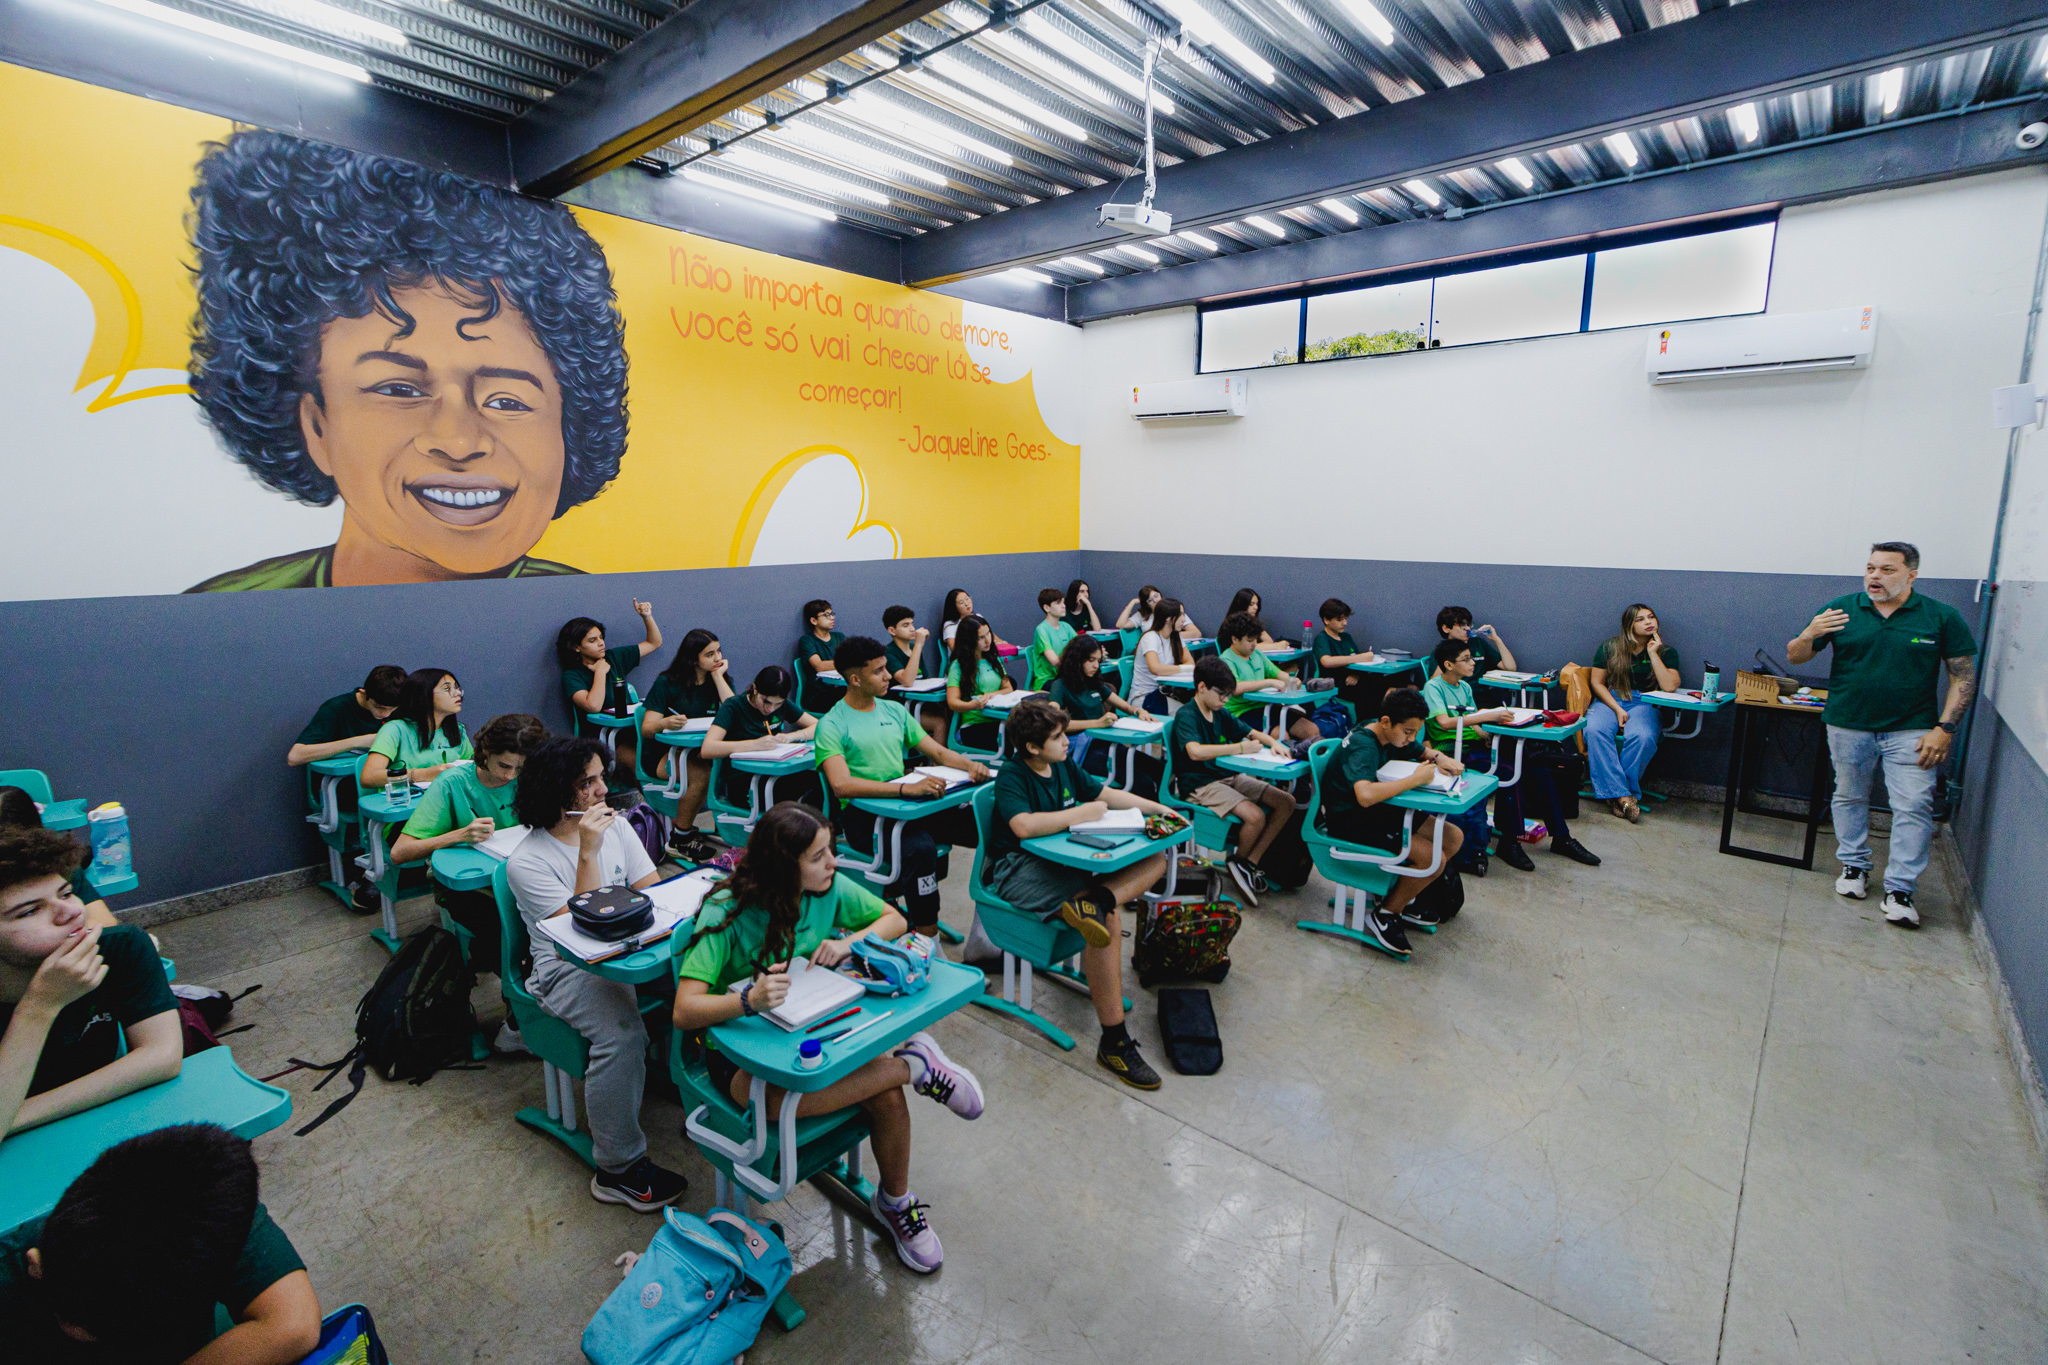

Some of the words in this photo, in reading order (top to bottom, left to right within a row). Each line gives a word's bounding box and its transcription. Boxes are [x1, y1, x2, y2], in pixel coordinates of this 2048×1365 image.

[668, 245, 732, 293] Não
[743, 266, 842, 317] importa
[854, 301, 931, 336] quanto
[940, 311, 1013, 354] demore,
[764, 322, 799, 354] só
[810, 333, 850, 362] vai
[863, 337, 940, 376] chegar
[947, 349, 968, 382] lá
[970, 363, 992, 386] se
[799, 382, 902, 414] começar!
[898, 425, 999, 462] -Jaqueline
[1006, 432, 1052, 461] Goes-
